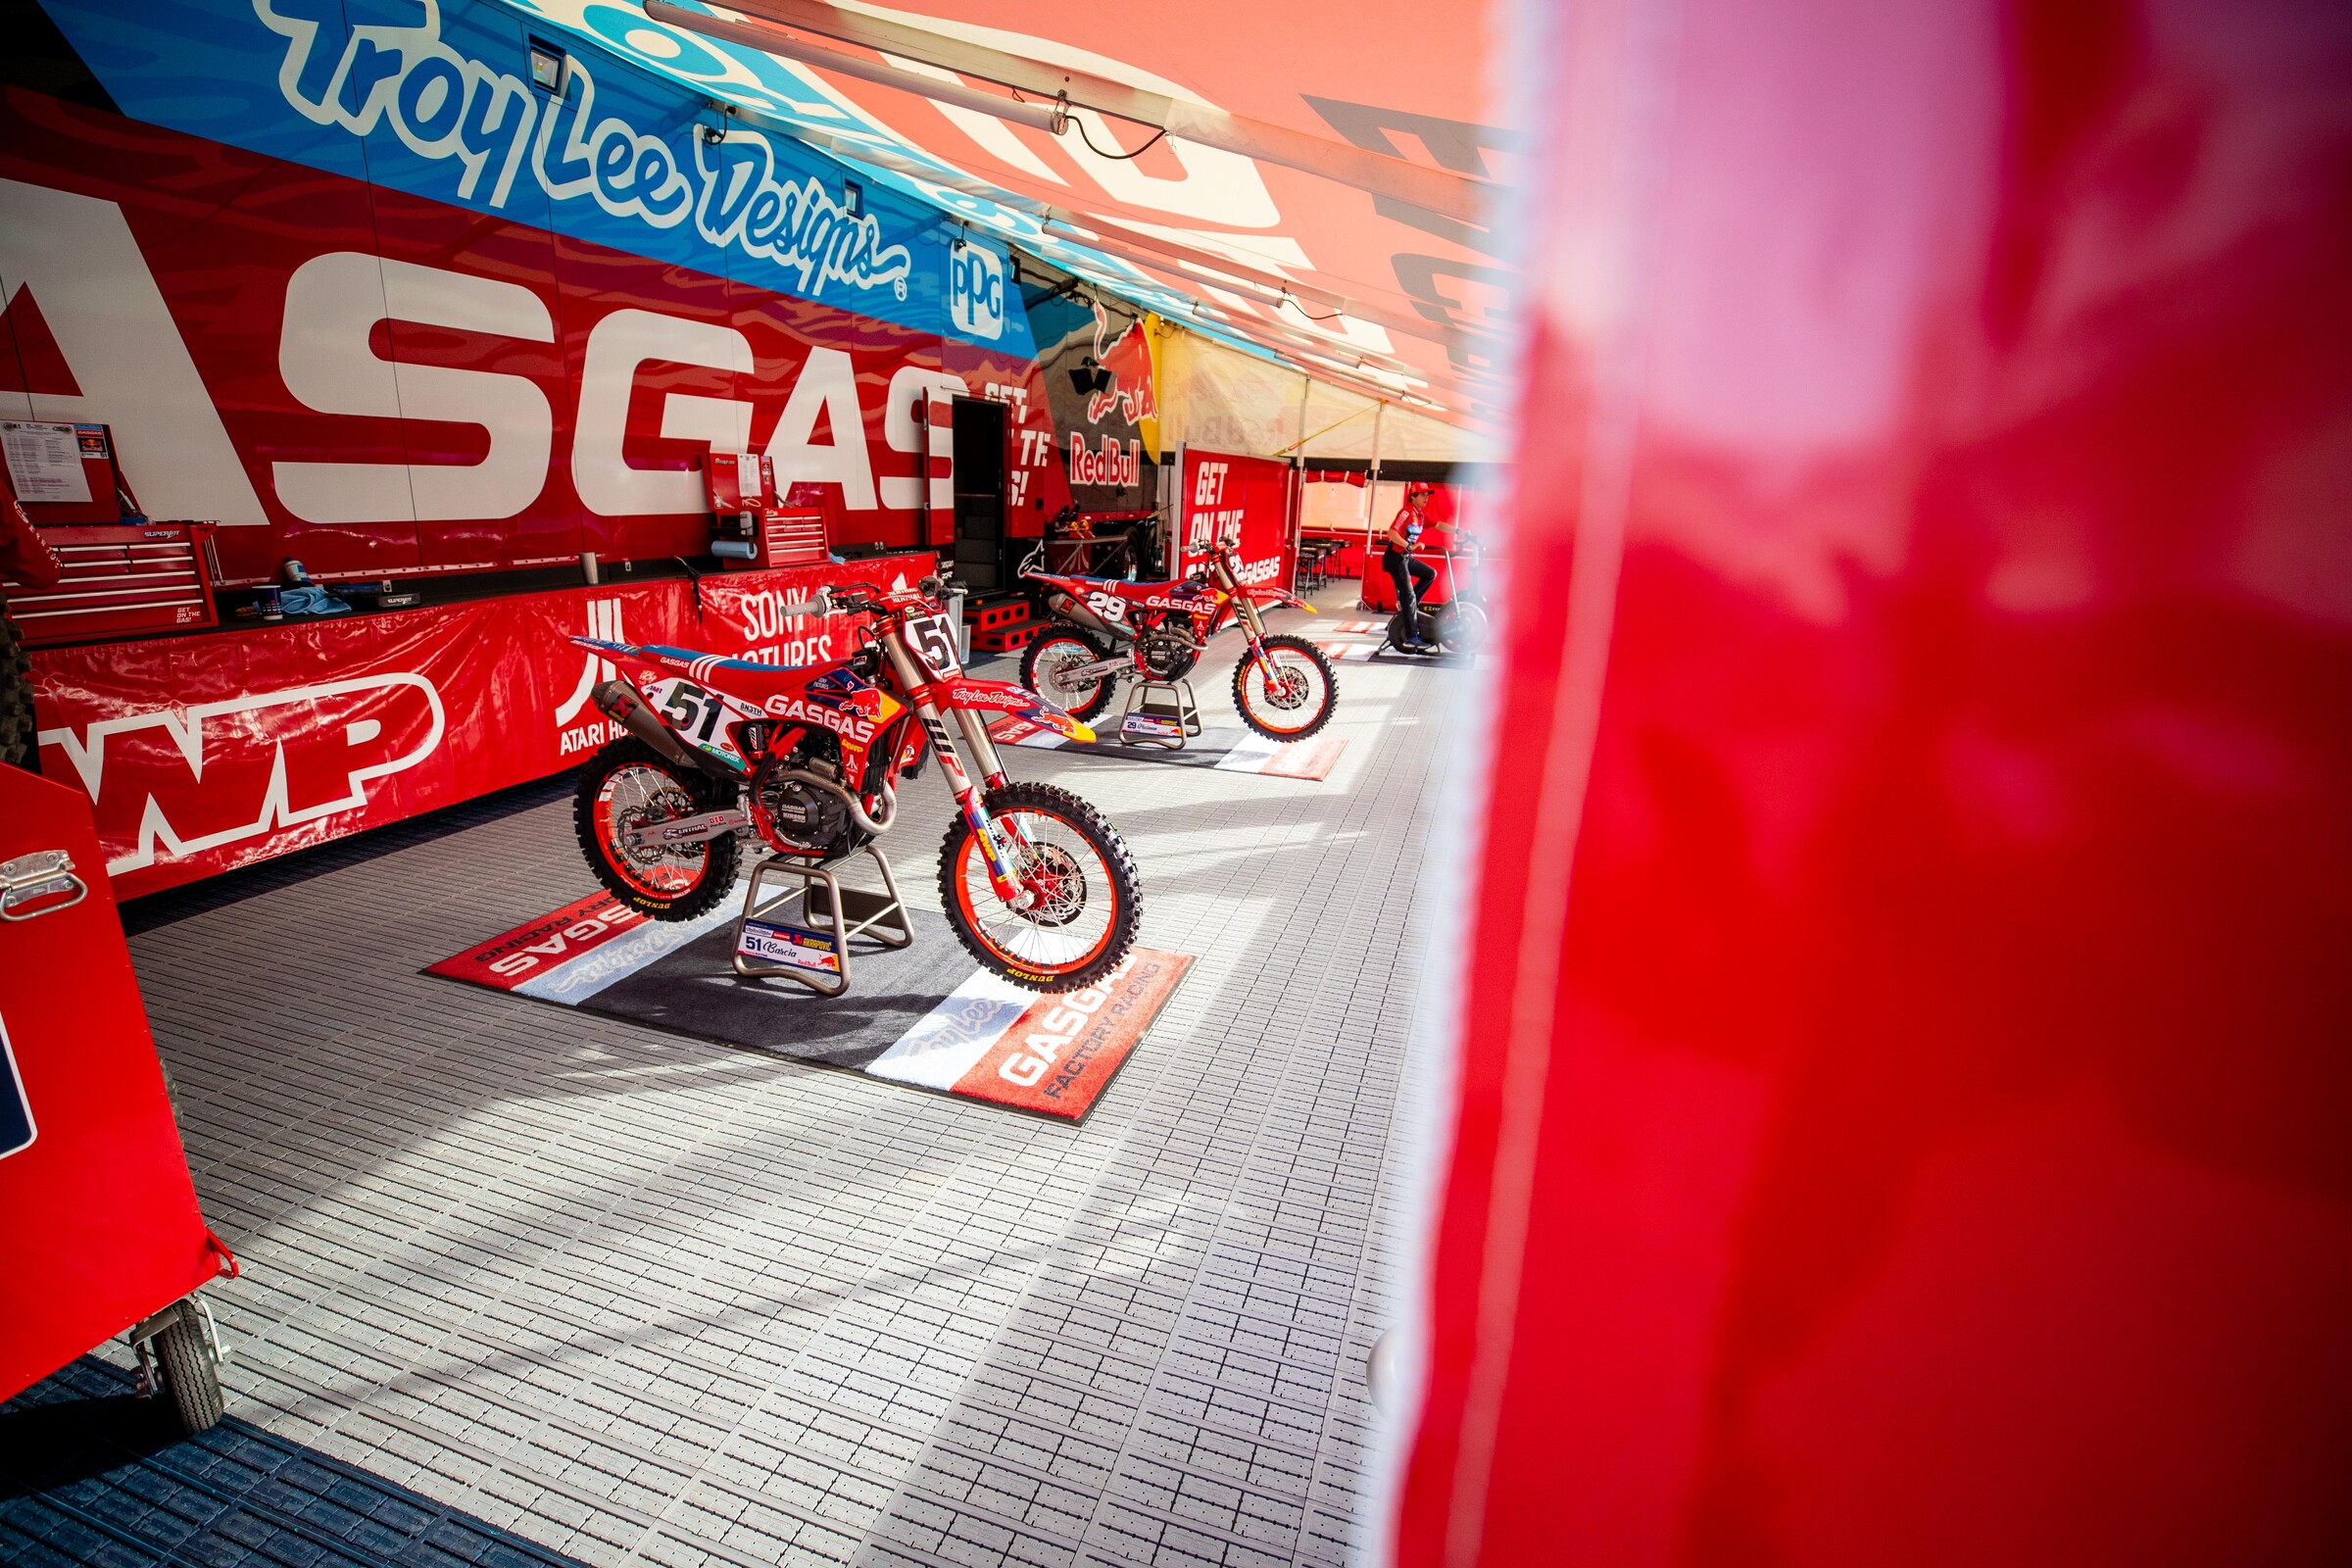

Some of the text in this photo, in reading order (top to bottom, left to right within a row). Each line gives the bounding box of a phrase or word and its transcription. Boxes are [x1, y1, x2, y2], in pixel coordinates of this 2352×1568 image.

[252, 0, 911, 297] Troy Lee Designs
[1070, 431, 1141, 487] Red Bull
[1195, 462, 1228, 507] GET
[1216, 510, 1244, 549] THE
[741, 587, 808, 642] SONY
[1086, 591, 1127, 621] 29
[1146, 596, 1217, 615] GASGAS
[660, 657, 690, 668] GASGAS
[912, 616, 960, 672] 51
[660, 681, 725, 743] 51
[740, 702, 762, 716] BN3TH
[953, 688, 974, 706] Troy
[972, 689, 989, 703] Lee
[764, 694, 875, 744] GASGAS
[560, 721, 605, 757] ATARI
[711, 748, 741, 763] MOTOREX
[633, 897, 671, 909] DUNLOP
[489, 905, 648, 977] SGAS
[745, 936, 762, 952] 51
[762, 941, 798, 957] Barcia
[1005, 967, 1055, 983] DUNLOP
[999, 954, 1139, 1087] GASGAS
[1043, 961, 1161, 1100] FACTORY RACING
